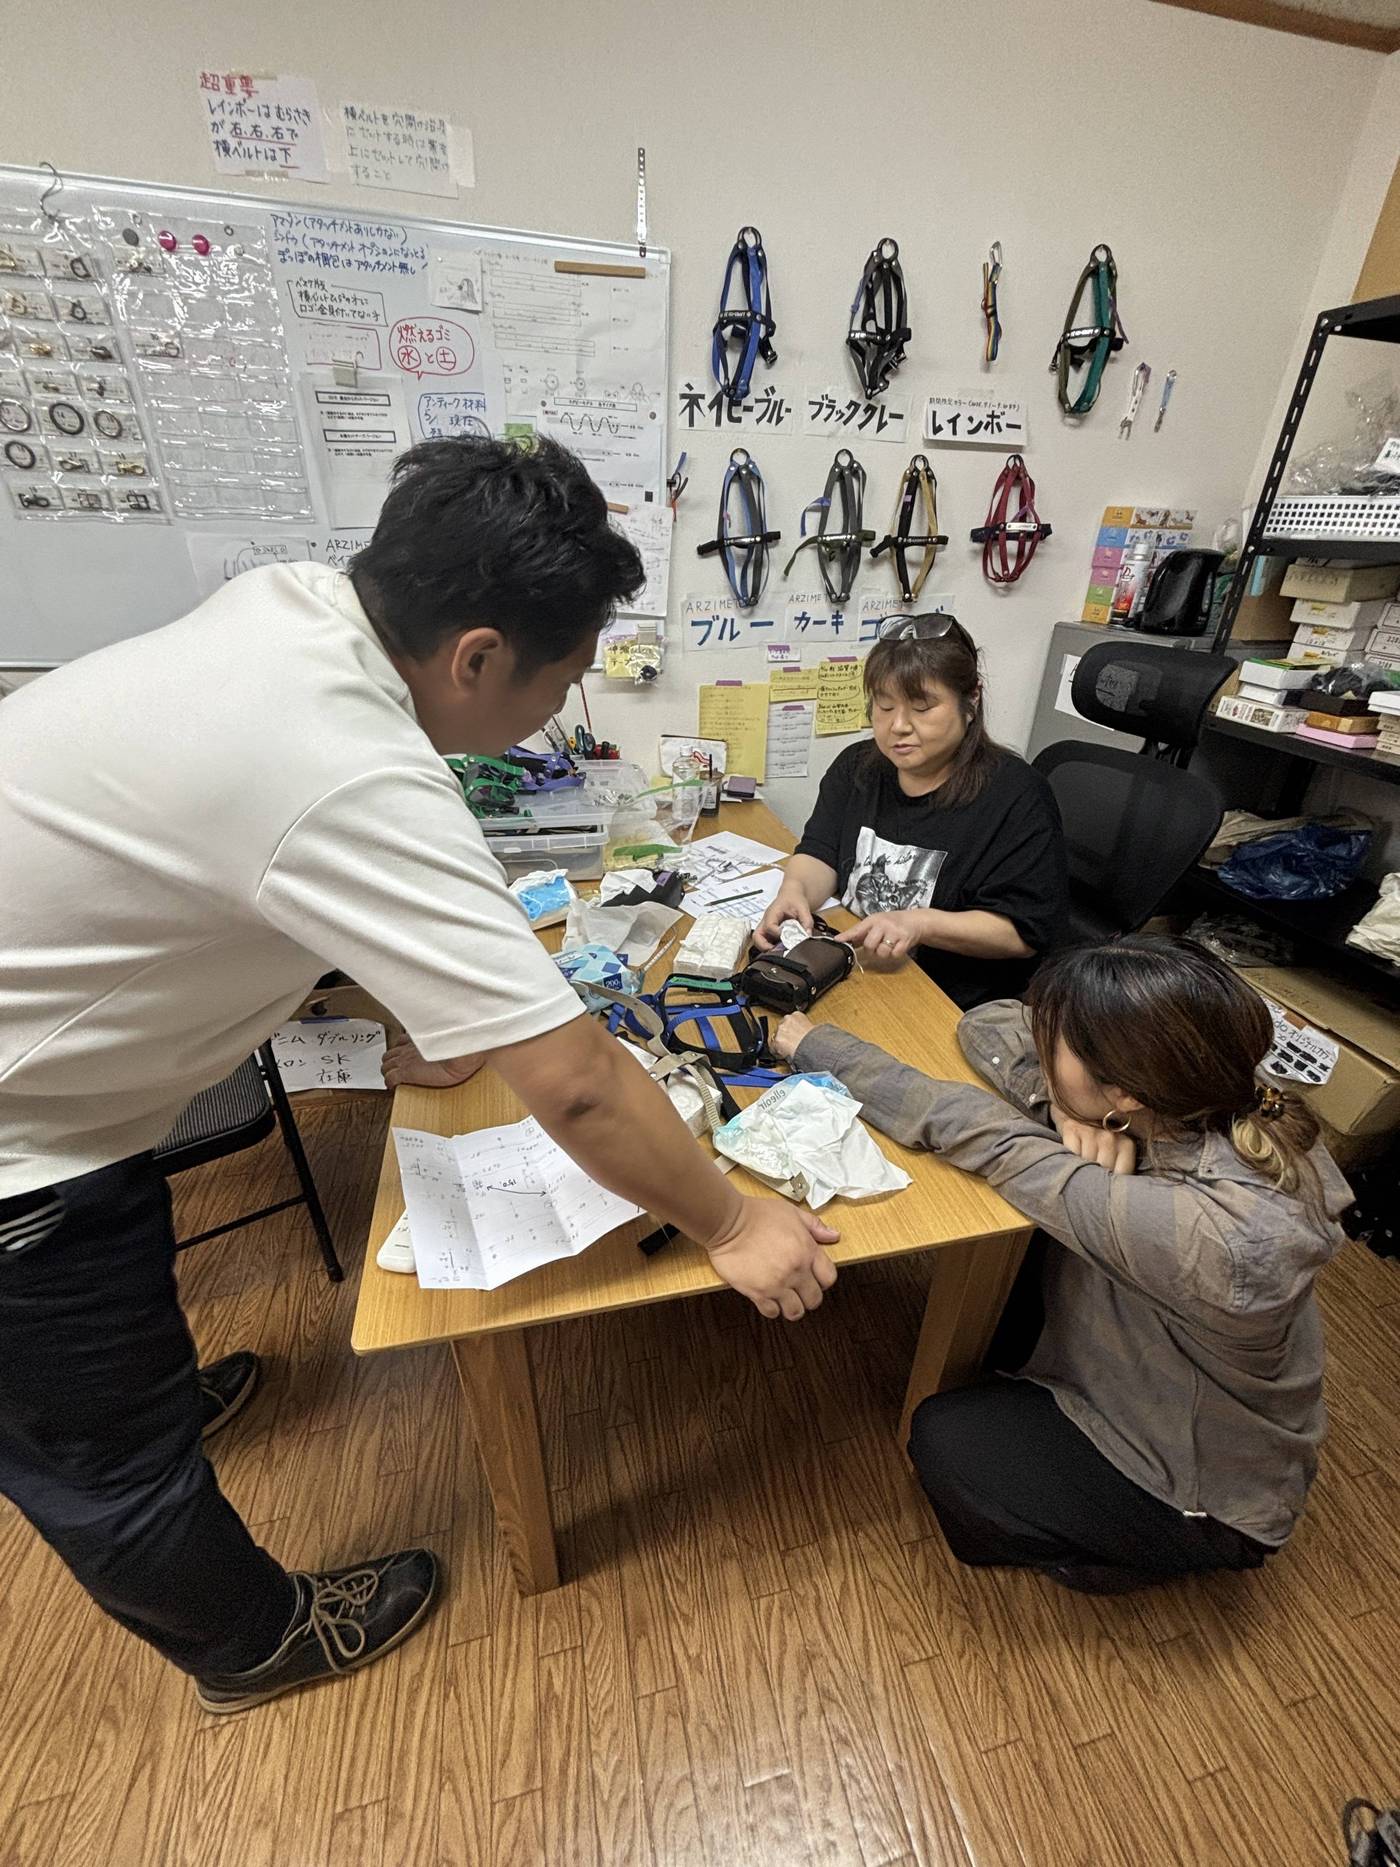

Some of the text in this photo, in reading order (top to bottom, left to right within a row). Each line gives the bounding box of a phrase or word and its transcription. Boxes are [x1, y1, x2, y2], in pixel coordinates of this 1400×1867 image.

[200, 72, 259, 98] 超重要
[207, 97, 311, 126] レインボーはむらさき
[213, 140, 292, 164] 横ベルトは下
[397, 323, 451, 344] 燃えるゴミ
[932, 409, 1022, 436] レインボー
[691, 614, 774, 646] ブルー
[793, 610, 845, 635] カーキ
